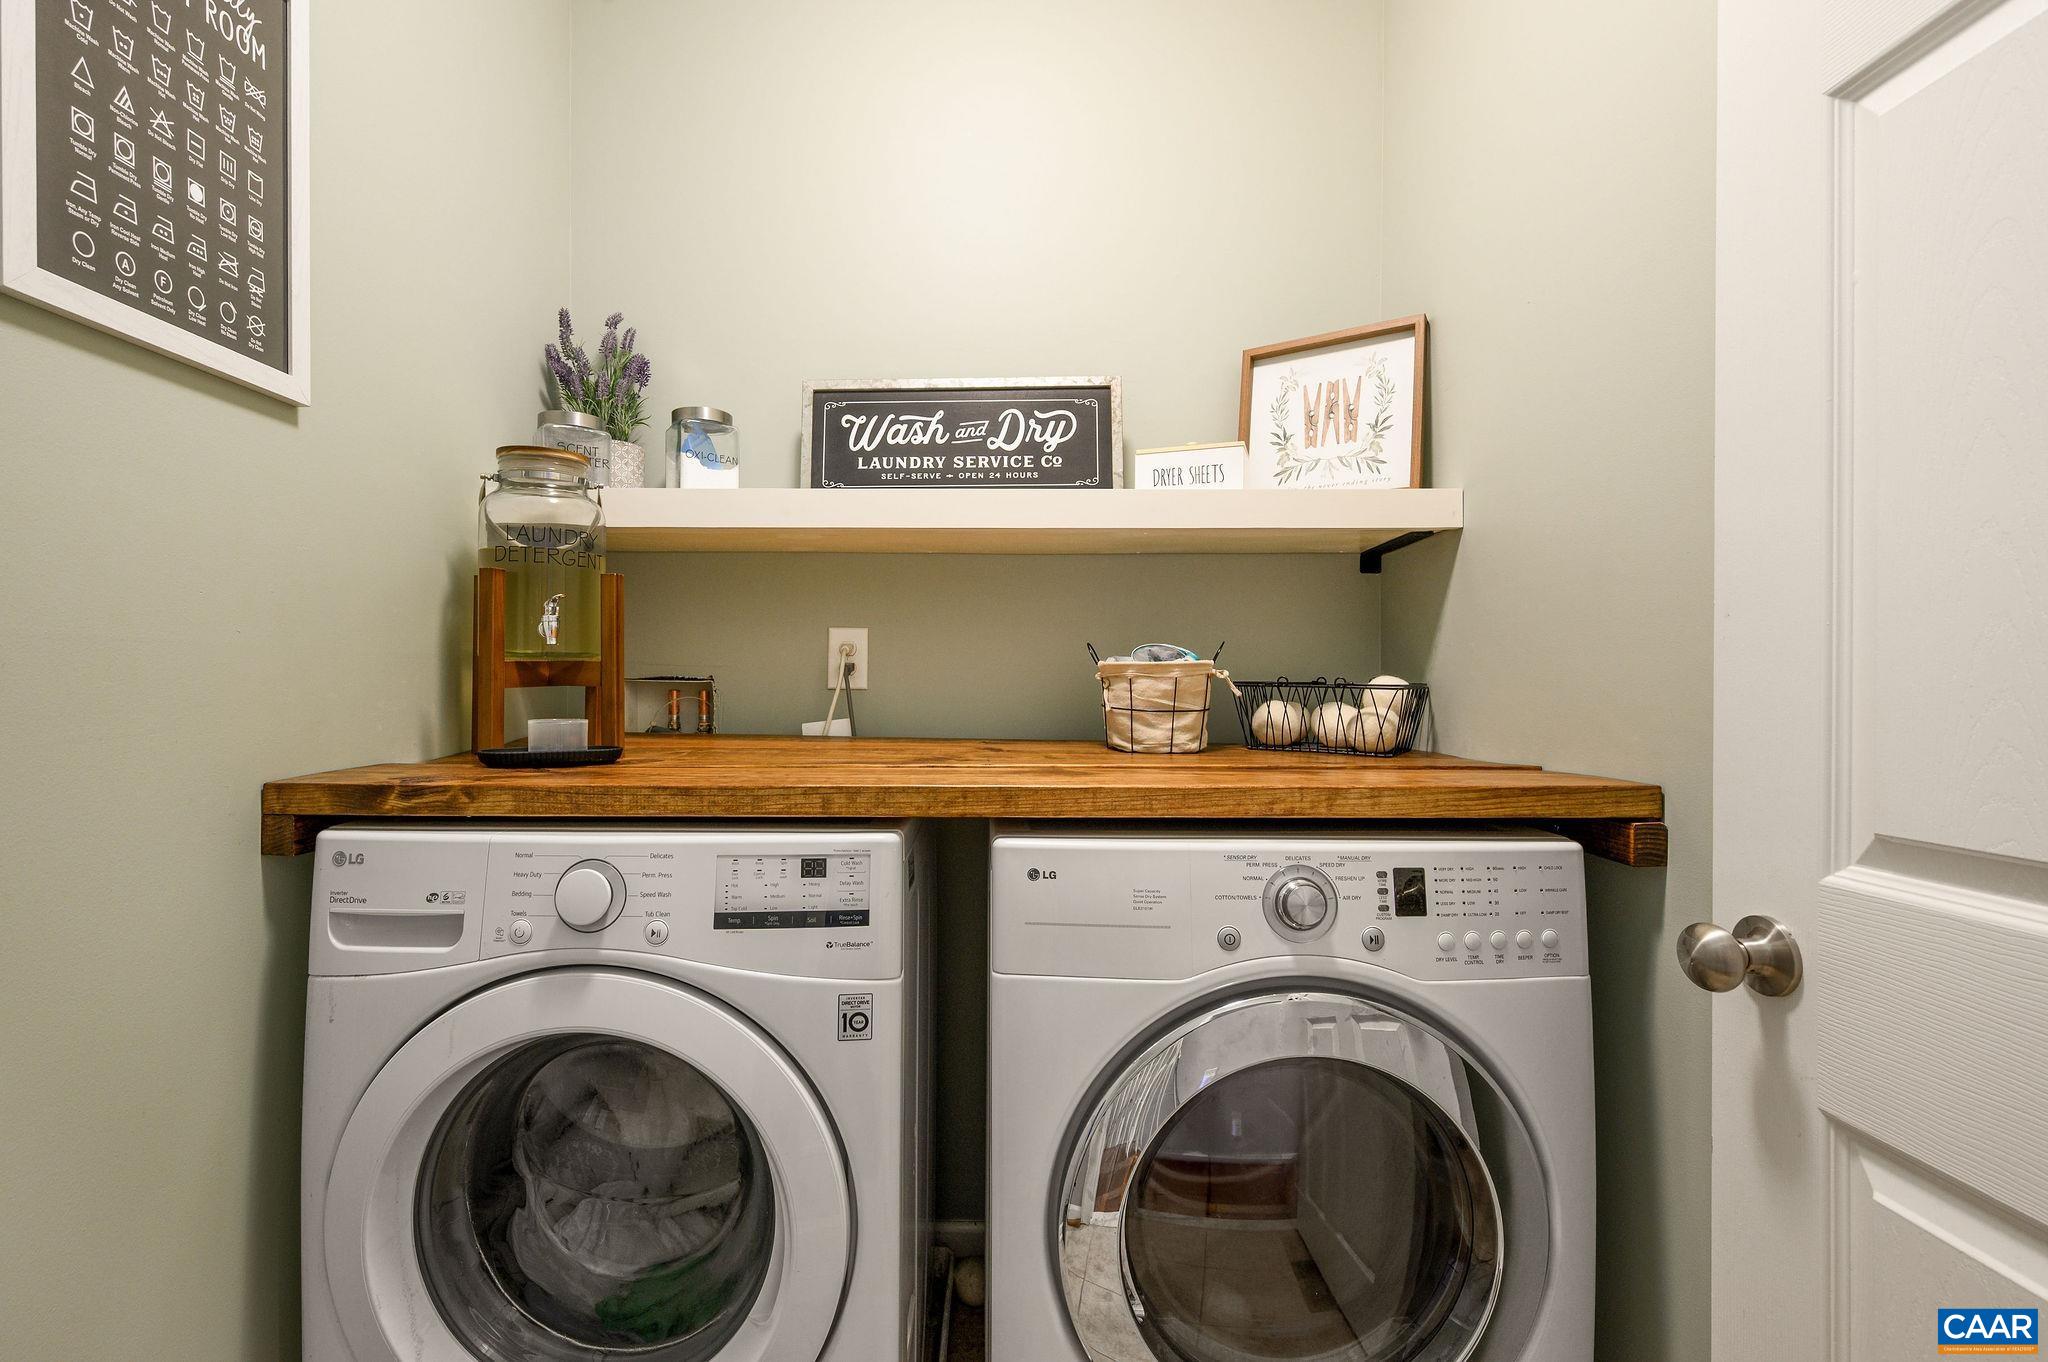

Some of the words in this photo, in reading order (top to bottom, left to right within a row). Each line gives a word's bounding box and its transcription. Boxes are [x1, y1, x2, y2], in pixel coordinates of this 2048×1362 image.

[64, 18, 86, 37] Machine
[85, 33, 100, 47] Wash
[76, 33, 89, 45] Cold
[206, 0, 266, 71] ROOM
[73, 81, 92, 97] Bleach
[109, 104, 139, 127] Non-Chlorine
[116, 116, 132, 130] Bleach
[69, 136, 88, 152] Tumble
[88, 148, 97, 159] Dry
[147, 128, 155, 137] Do
[162, 138, 177, 152] Bleach
[74, 146, 93, 161] Normal
[112, 161, 129, 176] Tumble
[129, 171, 138, 181] Dry
[77, 206, 88, 216] Any
[90, 218, 100, 228] Dry
[109, 221, 119, 231] Iron
[119, 227, 130, 237] Cool
[111, 229, 129, 243] Reverse
[150, 242, 160, 252] Iron
[71, 256, 81, 266] Dry
[81, 260, 96, 272] Clean
[121, 258, 130, 271] A
[114, 275, 124, 285] Dry
[123, 279, 137, 290] Clean
[160, 276, 167, 287] F
[112, 282, 122, 292] Any
[122, 286, 140, 298] Solvent
[150, 299, 166, 311] Solvent
[166, 305, 176, 316] Only
[840, 409, 950, 452] Wash
[955, 419, 988, 440] and
[986, 408, 1078, 453] Dry
[557, 442, 599, 457] SCENT
[685, 449, 738, 466] OXI-CLEAN
[857, 455, 947, 470] LAUNDRY
[953, 455, 1035, 469] SERVICE
[881, 472, 942, 480] SELF-SERVE
[1005, 471, 1039, 479] HOURS
[1152, 467, 1184, 487] DRYER
[1188, 463, 1225, 485] SHEETS
[506, 524, 599, 548] LAUNDRY
[494, 545, 602, 570] DETERGENT
[348, 853, 365, 865] LG
[649, 852, 674, 860] Delicates
[513, 871, 529, 879] Heavy
[529, 871, 543, 879] Duty
[1042, 870, 1057, 880] LG
[511, 890, 532, 898] Bedding
[640, 891, 656, 899] Speed
[841, 1012, 869, 1033] 10
